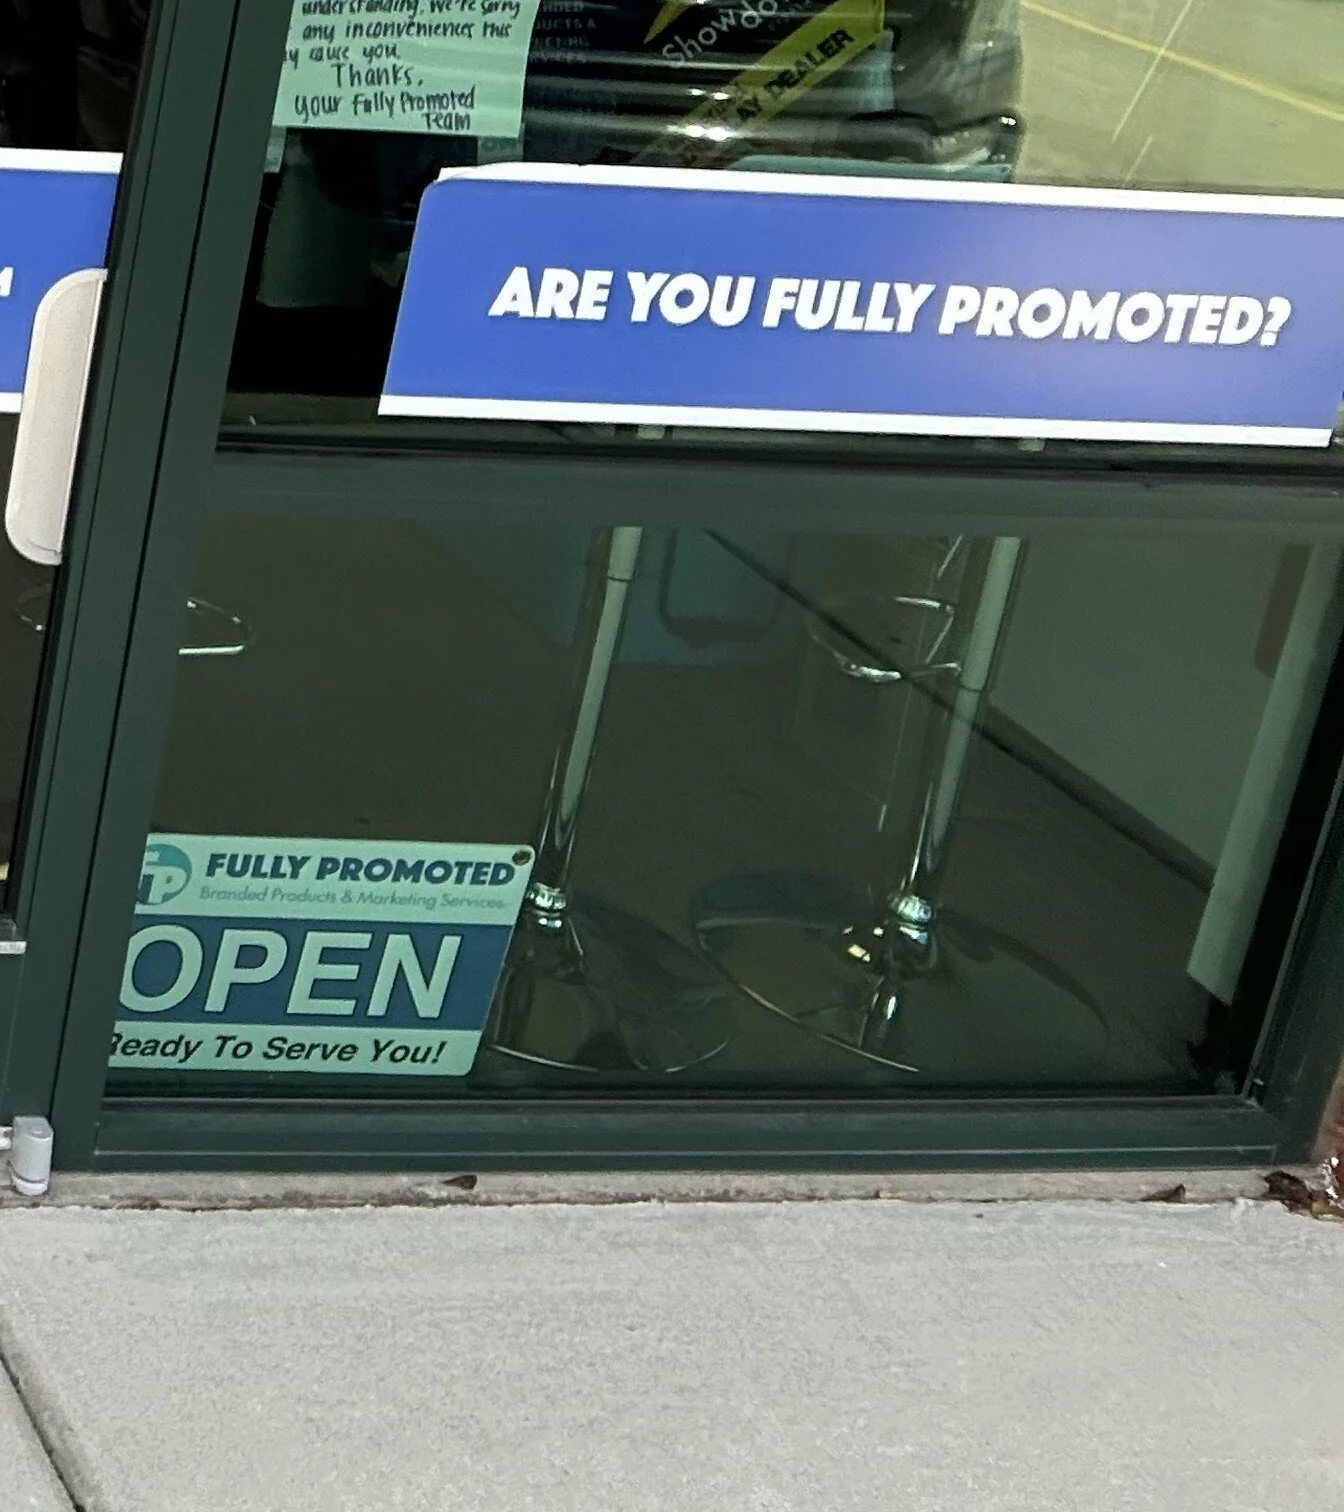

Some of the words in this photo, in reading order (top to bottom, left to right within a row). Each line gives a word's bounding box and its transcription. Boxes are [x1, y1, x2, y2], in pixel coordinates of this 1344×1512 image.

[302, 24, 337, 44] any
[765, 28, 855, 98] DEALER
[352, 89, 397, 119] Fully
[400, 84, 477, 114] Promoted
[421, 112, 472, 132] Team
[488, 265, 614, 322] ARE
[626, 269, 758, 328] YOU
[761, 276, 940, 336] FULLY
[936, 284, 1294, 348] PROMOTED?
[205, 852, 311, 880] FULLY
[316, 856, 516, 886] PROMOTED
[200, 885, 268, 903] Branded
[271, 887, 337, 905] Products
[340, 890, 353, 903] &
[358, 892, 438, 911] Marketing
[439, 892, 506, 909] Services
[120, 923, 462, 1019] OPEN
[214, 1034, 254, 1059] To
[262, 1035, 360, 1064] Serve
[370, 1037, 449, 1066] You!
